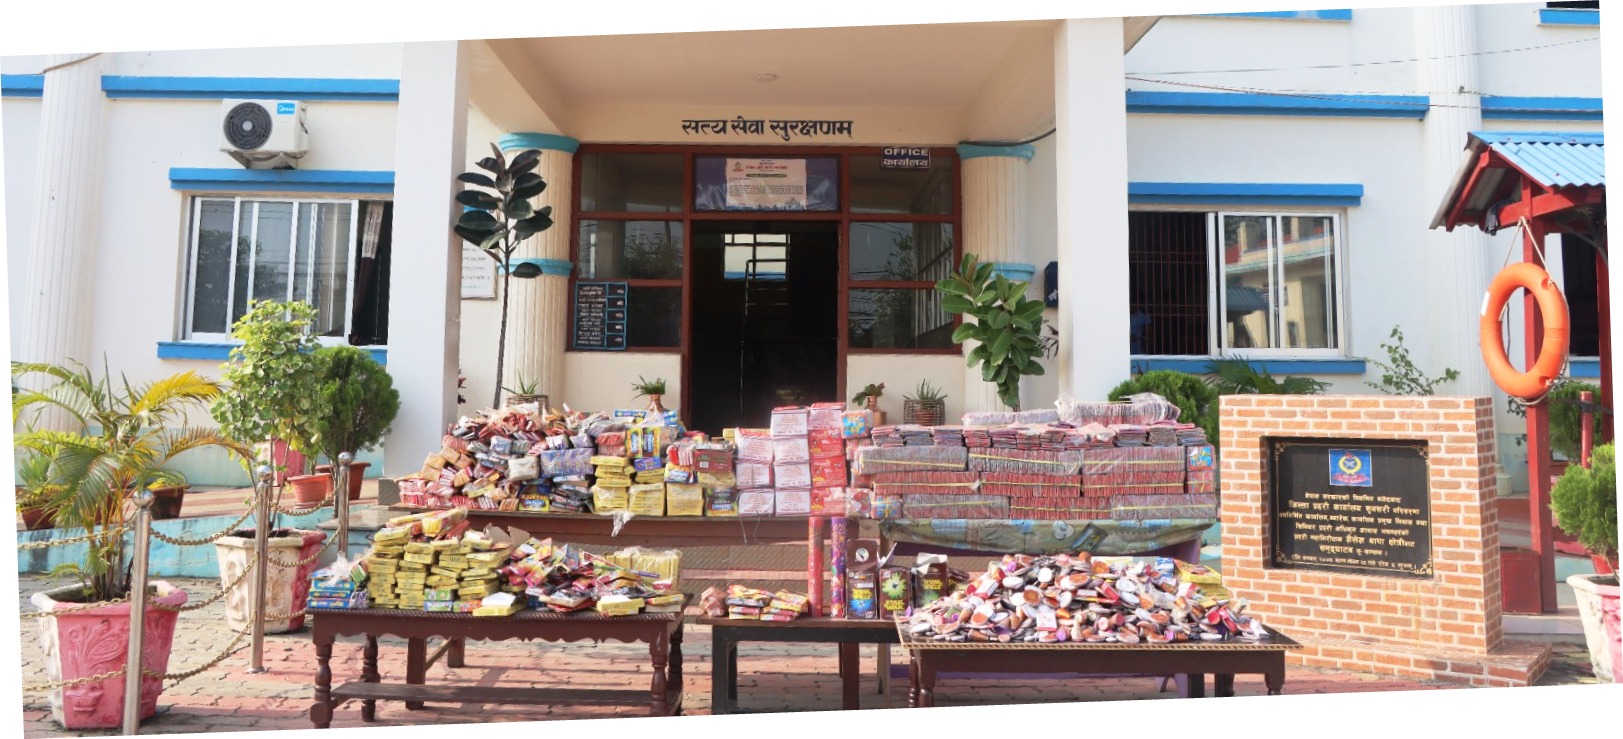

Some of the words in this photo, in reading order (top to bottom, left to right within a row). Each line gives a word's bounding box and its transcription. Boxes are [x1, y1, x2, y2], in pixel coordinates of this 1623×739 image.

[682, 119, 727, 135] सत्य
[730, 115, 764, 135] सेवा
[769, 119, 854, 141] सुरक्षणम्
[884, 147, 928, 156] OFFICE
[883, 156, 928, 167] कार्यालय
[1289, 499, 1309, 508] जिल्ला
[1312, 501, 1330, 510] प्रहरी
[1333, 502, 1361, 511] कार्यालय
[1365, 505, 1390, 514] सुनसरी
[1369, 537, 1385, 545] थापा
